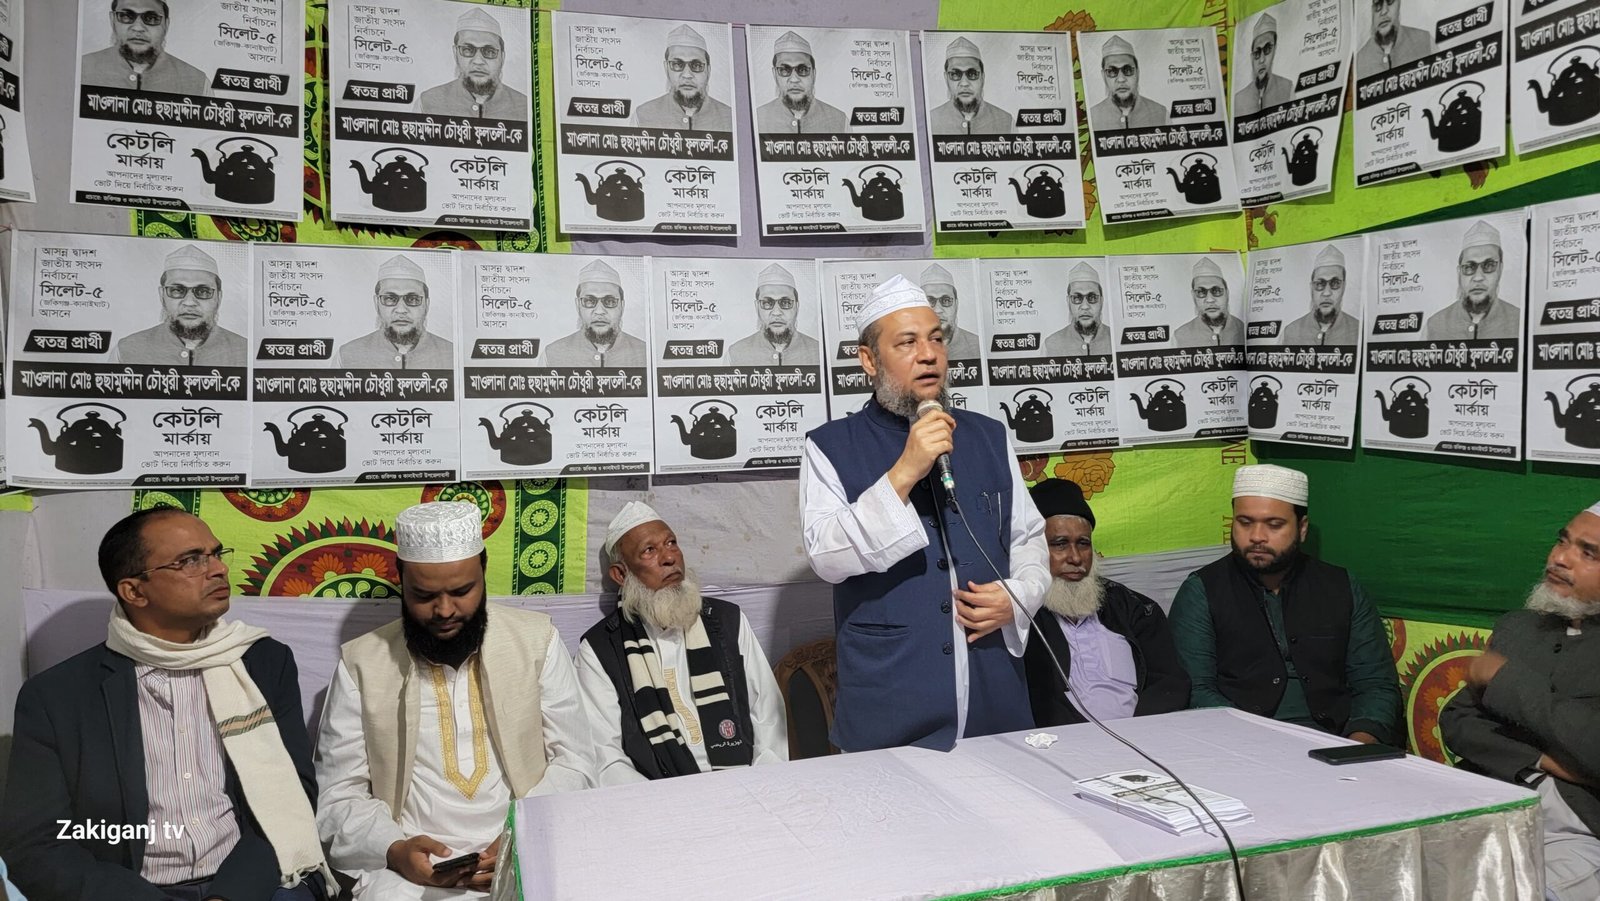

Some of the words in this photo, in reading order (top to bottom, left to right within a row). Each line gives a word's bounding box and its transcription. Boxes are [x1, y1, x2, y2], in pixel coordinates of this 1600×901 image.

[218, 22, 276, 44] সিলেট-৫
[353, 35, 407, 54] সিলেট-৫
[575, 54, 623, 71] সিলেট-৫
[107, 130, 176, 154] কেটলি
[115, 153, 165, 169] মার্কায়
[450, 155, 508, 176] কেটলি
[458, 175, 499, 191] মার্কায়
[664, 165, 716, 184] কেটলি
[953, 167, 997, 185] কেটলি
[672, 184, 709, 199] মার্কায়
[39, 280, 103, 299] সিলেট-৫
[268, 291, 325, 308] সিলেট-৫
[480, 294, 532, 310] সিলেট-৫
[670, 298, 716, 313] সিলেট-৫
[1297, 378, 1339, 398] কেটলি
[153, 406, 222, 428] কেটলি
[371, 407, 432, 429] কেটলি
[574, 403, 628, 423] কেটলি
[756, 399, 804, 419] কেটলি
[581, 423, 621, 438] মার্কায়
[763, 418, 798, 432] মার্কায়
[162, 429, 212, 445] মার্কায়
[380, 428, 424, 444] মার্কায়
